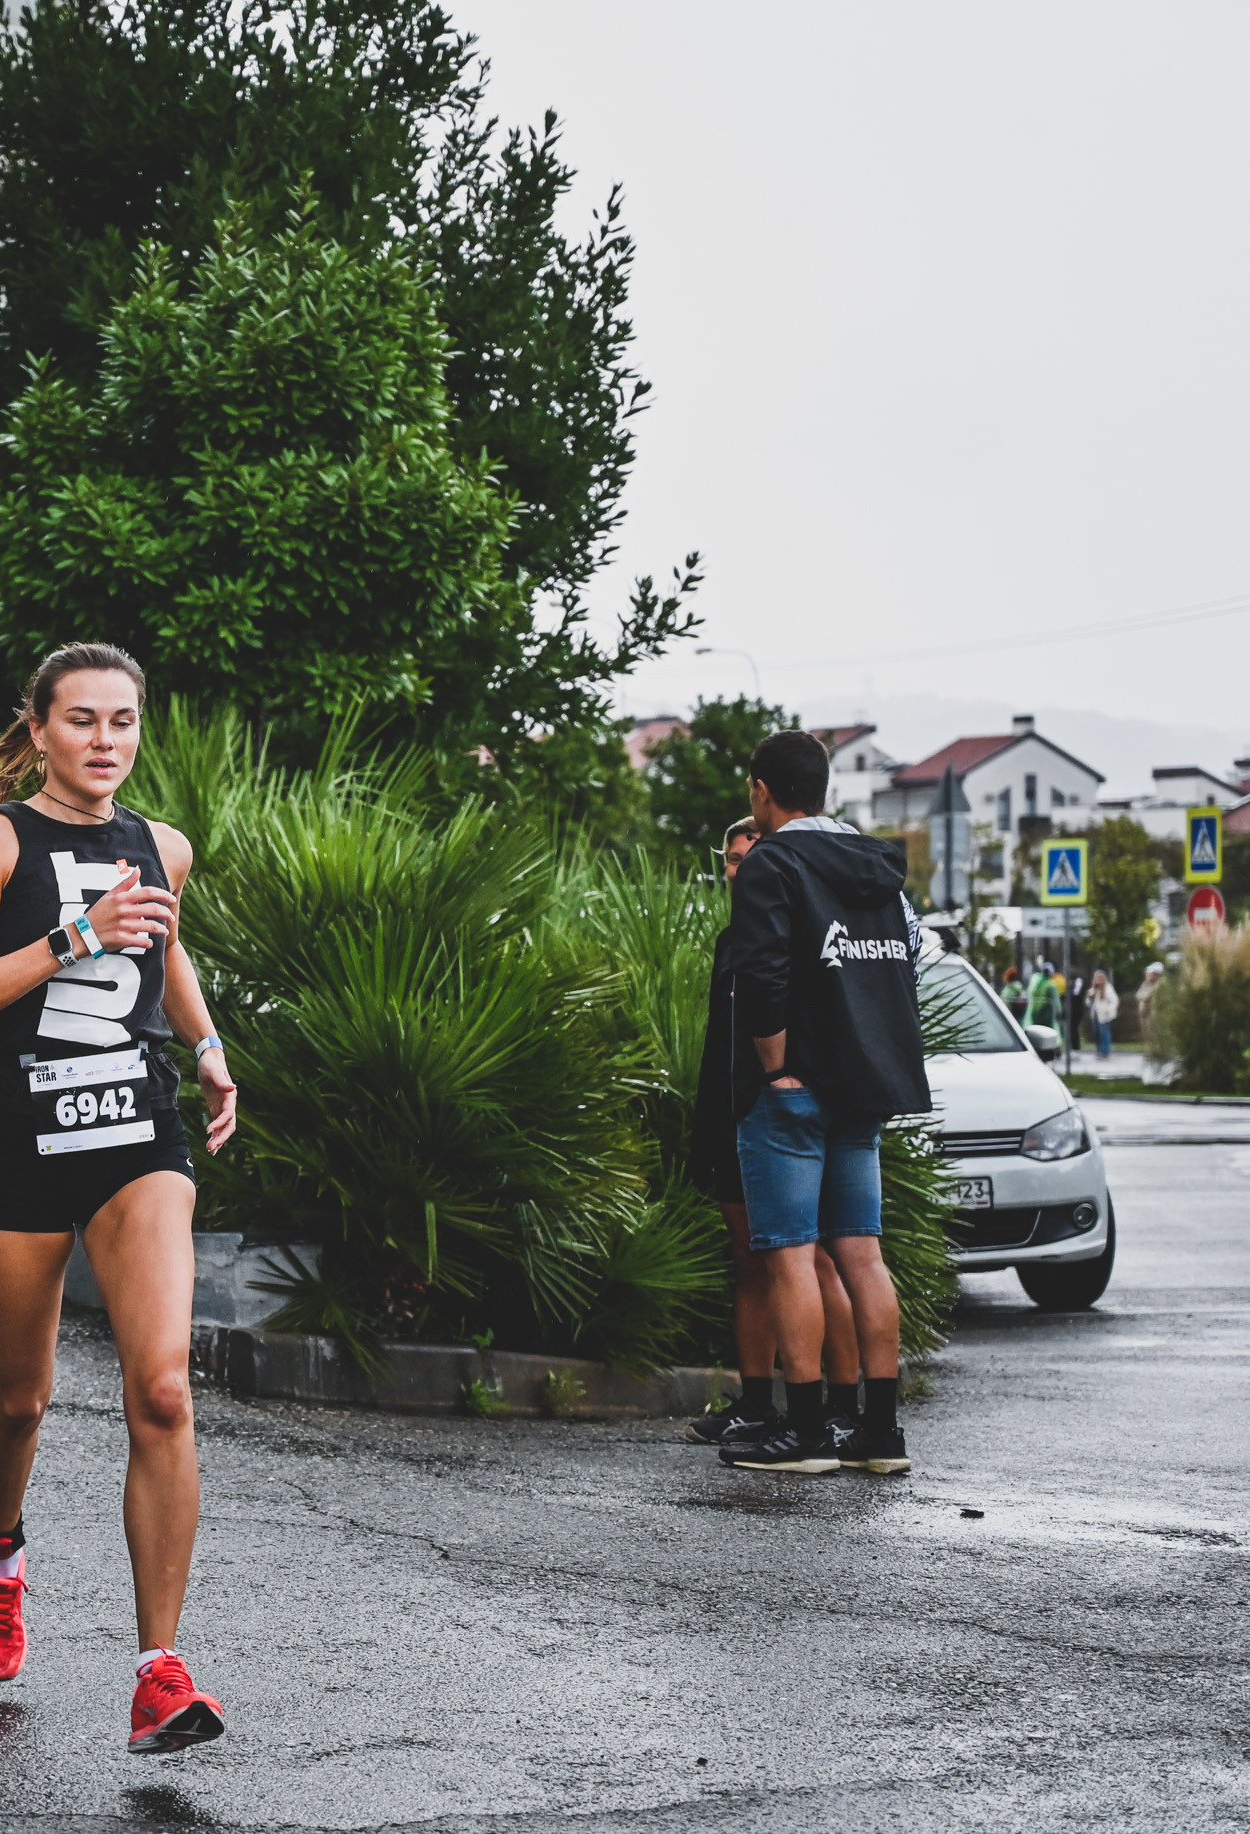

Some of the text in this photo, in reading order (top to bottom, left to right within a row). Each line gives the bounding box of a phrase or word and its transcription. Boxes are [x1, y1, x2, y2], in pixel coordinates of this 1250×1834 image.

[838, 937, 909, 961] FINISHER
[35, 1064, 50, 1074] IRON
[36, 1071, 57, 1083] STAR
[56, 1086, 137, 1127] 6942
